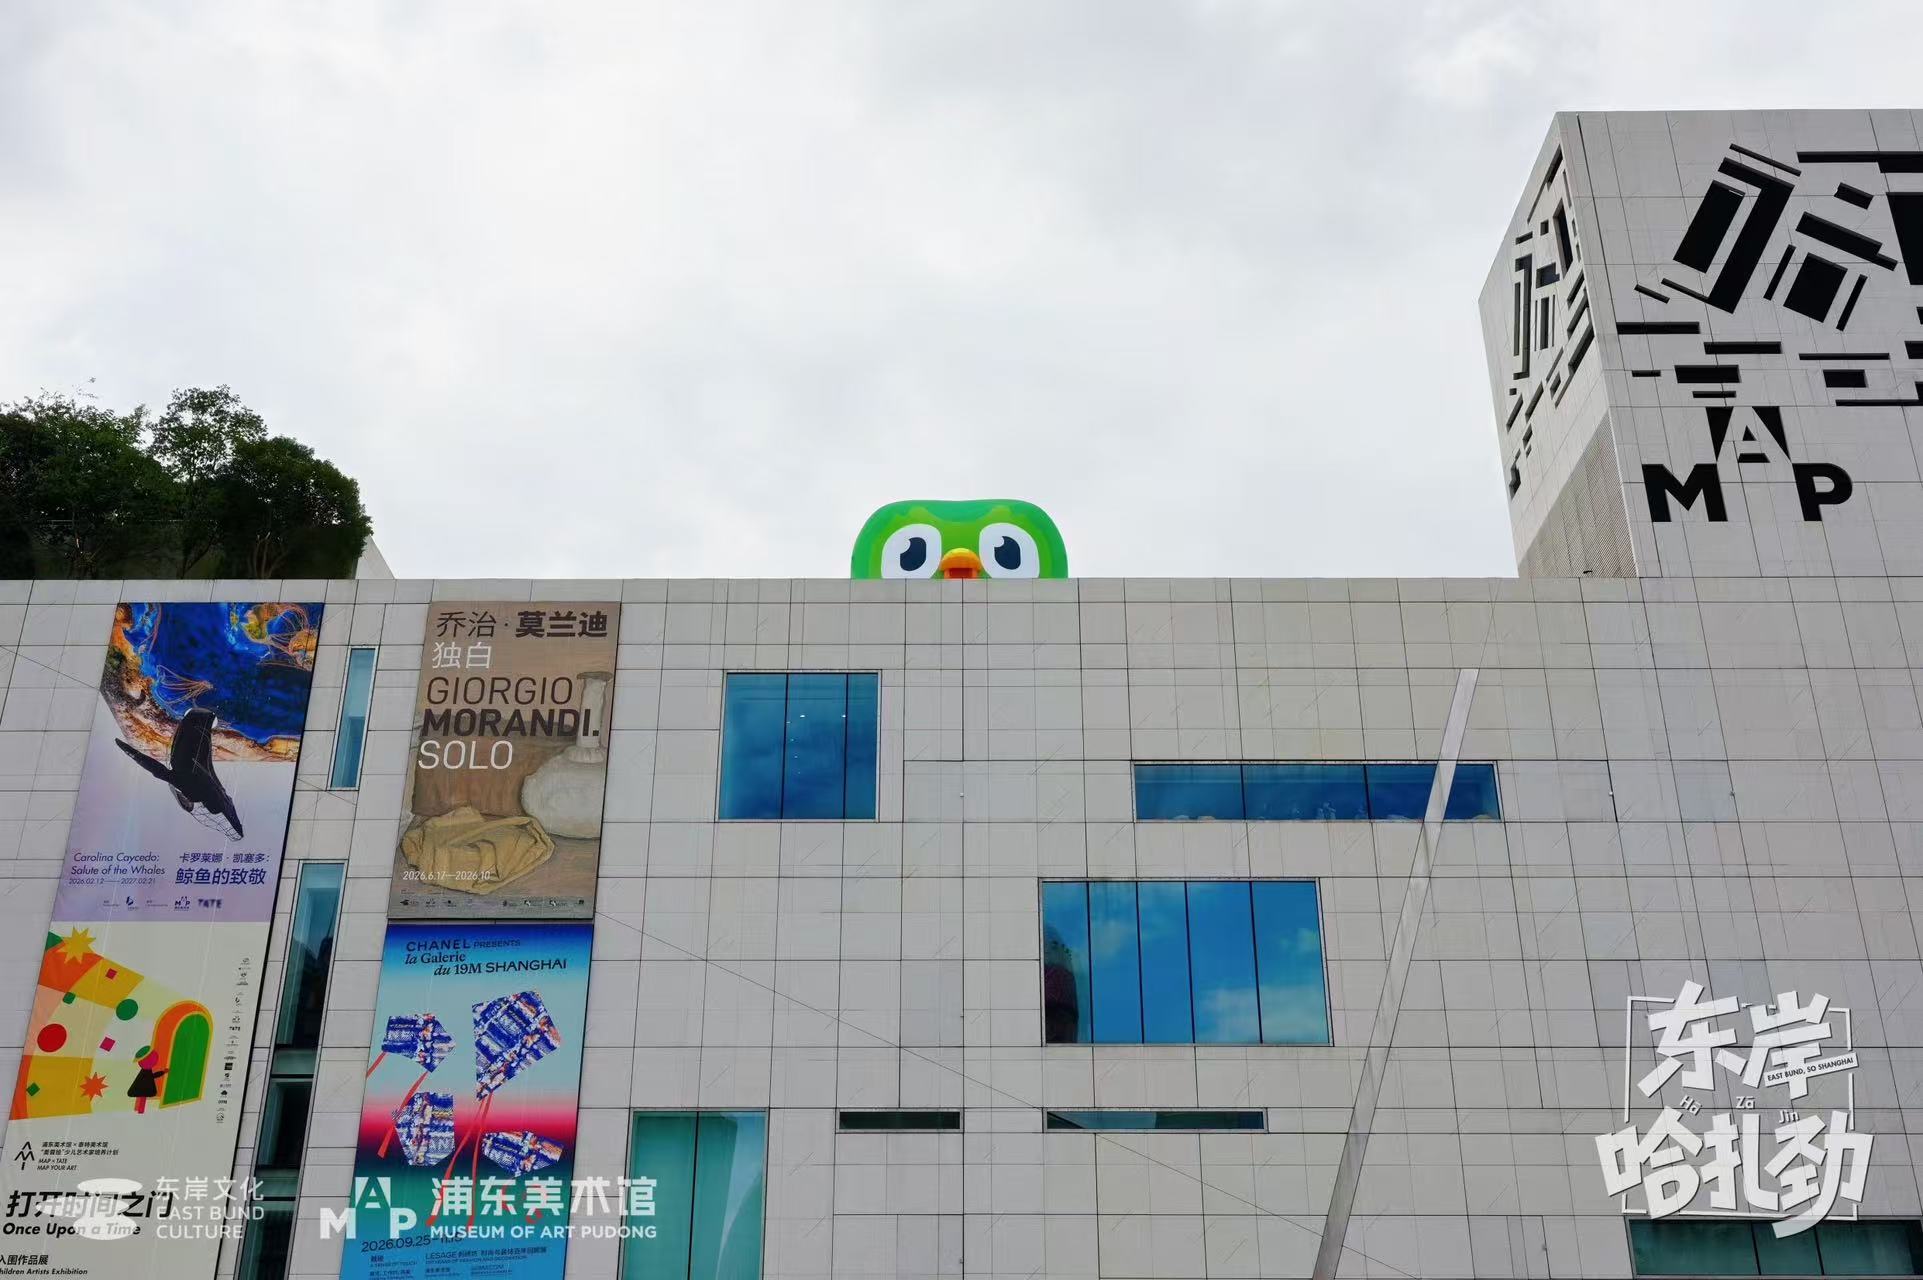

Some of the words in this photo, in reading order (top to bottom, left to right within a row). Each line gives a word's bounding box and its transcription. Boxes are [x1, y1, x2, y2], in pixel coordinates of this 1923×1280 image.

[1641, 406, 1853, 522] MAP
[437, 610, 608, 638] 乔治·莫兰迪
[432, 641, 492, 669] 独白
[427, 676, 573, 705] GIORGIO
[422, 708, 600, 737] MORANDI.
[418, 740, 513, 769] SOLO
[73, 851, 113, 862] Carolina
[116, 851, 160, 864] Caycedo:
[71, 865, 99, 875] Salute
[101, 864, 113, 875] of
[113, 864, 128, 875] the
[131, 864, 166, 875] Whales
[175, 867, 267, 885] 鲸鱼的致敬
[406, 939, 471, 952] CHANEL
[473, 939, 521, 949] PRESENTS
[405, 953, 417, 965] la
[420, 951, 466, 964] Galerie
[434, 965, 450, 976] du
[454, 963, 482, 975] 19M
[485, 958, 567, 974] SHANGHAI
[3, 1222, 41, 1235] Once
[46, 1223, 86, 1238] Upon
[91, 1226, 102, 1235] a
[106, 1222, 141, 1235] Time
[425, 1251, 457, 1260] LESAGE
